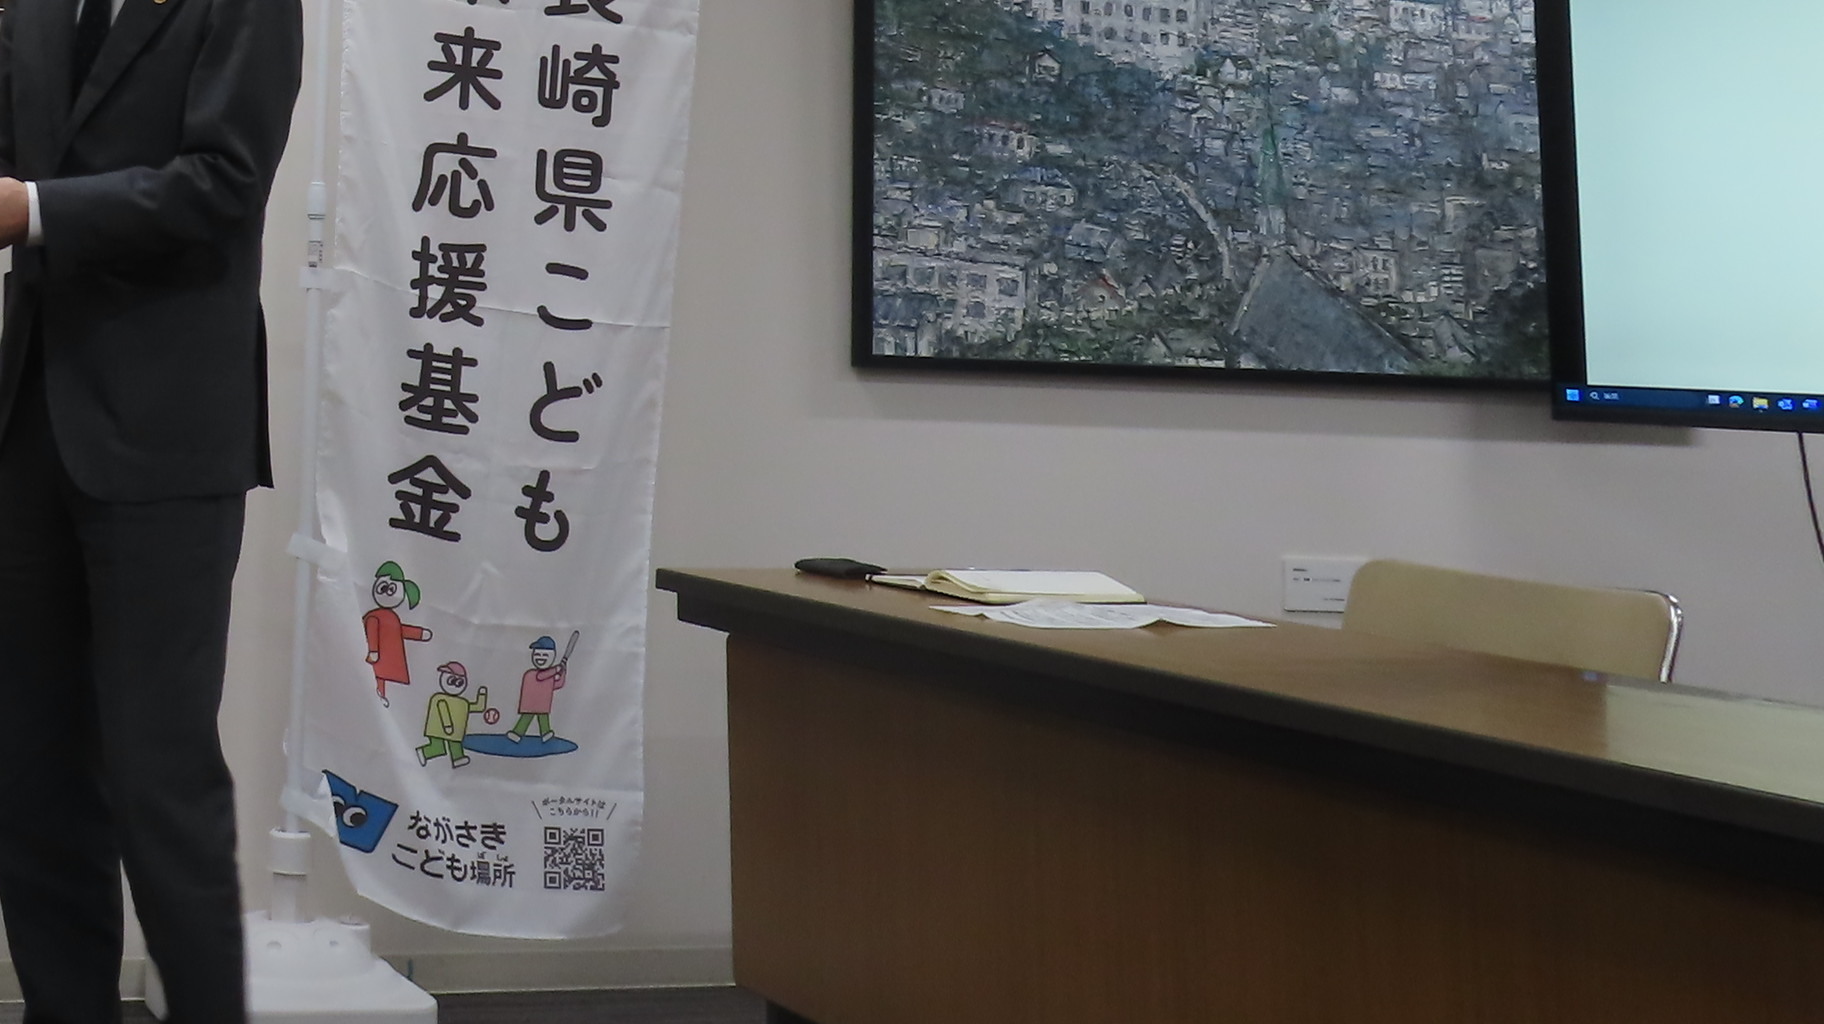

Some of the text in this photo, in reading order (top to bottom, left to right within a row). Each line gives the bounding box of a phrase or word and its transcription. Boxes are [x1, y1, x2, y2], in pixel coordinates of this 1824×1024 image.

[407, 810, 507, 851] ながさき
[391, 843, 516, 889] こども場所
